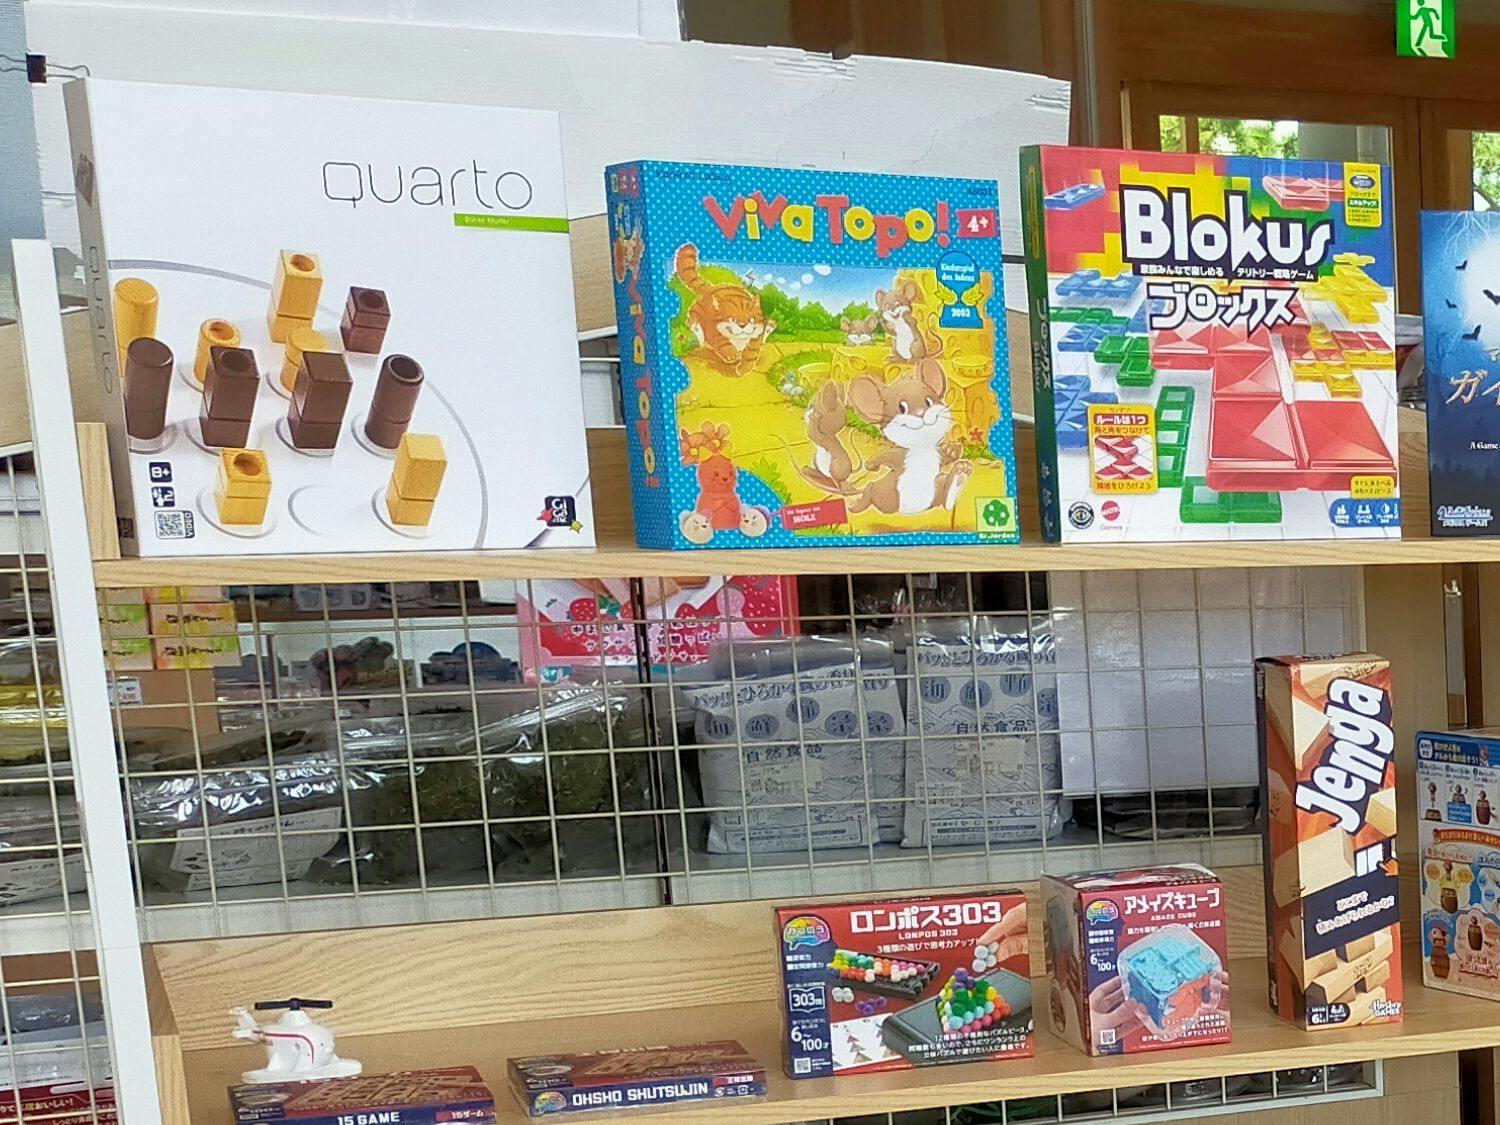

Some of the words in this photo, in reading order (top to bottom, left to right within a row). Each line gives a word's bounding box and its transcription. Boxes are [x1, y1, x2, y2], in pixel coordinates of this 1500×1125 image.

[816, 194, 950, 259] Topo!
[966, 215, 991, 233] 4+
[1123, 188, 1331, 268] Blokus
[1149, 284, 1298, 334] ブロックス
[1477, 441, 1498, 451] Game
[1296, 677, 1395, 835] Jenga
[1123, 887, 1220, 915] アメイズキューブ
[850, 901, 1001, 933] ロンポス303
[898, 930, 937, 940] LONPOS
[939, 928, 958, 938] 303
[572, 1090, 622, 1107] OHSHO
[628, 1082, 708, 1103] SHUTSUJIN
